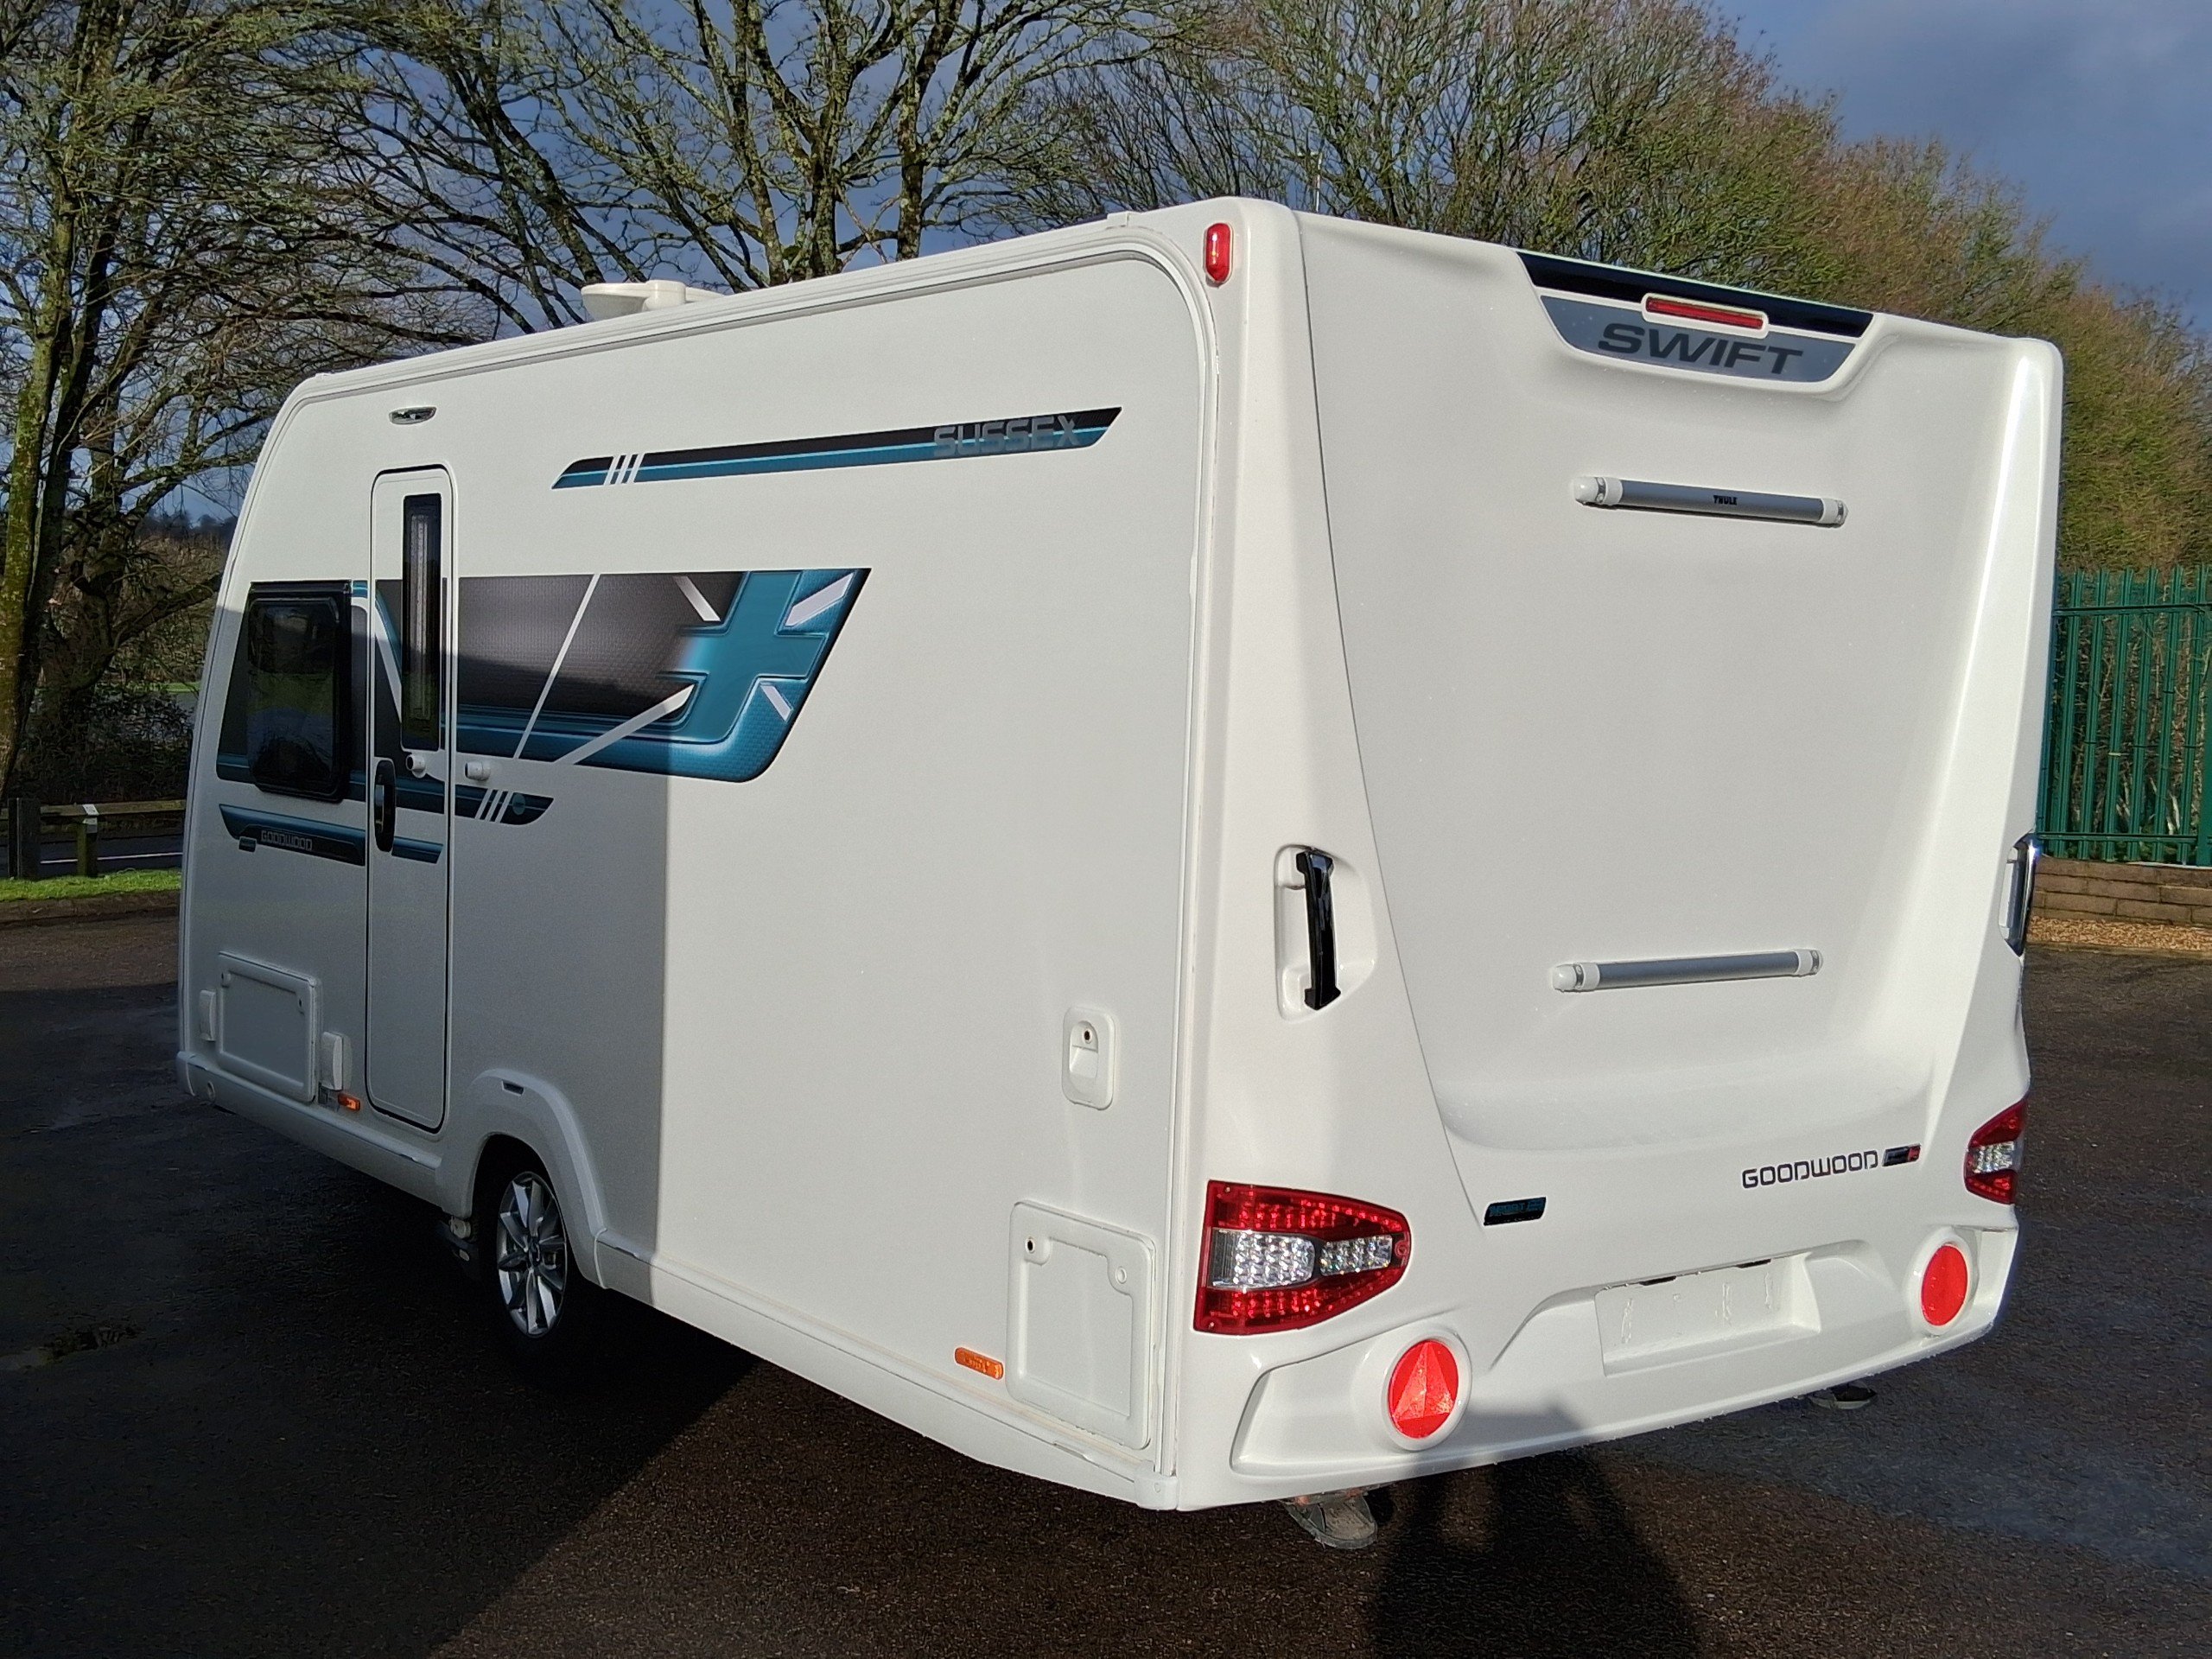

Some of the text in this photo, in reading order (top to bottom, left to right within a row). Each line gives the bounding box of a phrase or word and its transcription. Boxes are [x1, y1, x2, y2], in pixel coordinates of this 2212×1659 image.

[1598, 323, 1803, 374] SWIFT
[933, 415, 1081, 457] SUSSEX
[1713, 494, 1738, 506] THULE
[260, 830, 313, 851] GOODWOOD
[1742, 1150, 1878, 1189] GOODWOOD
